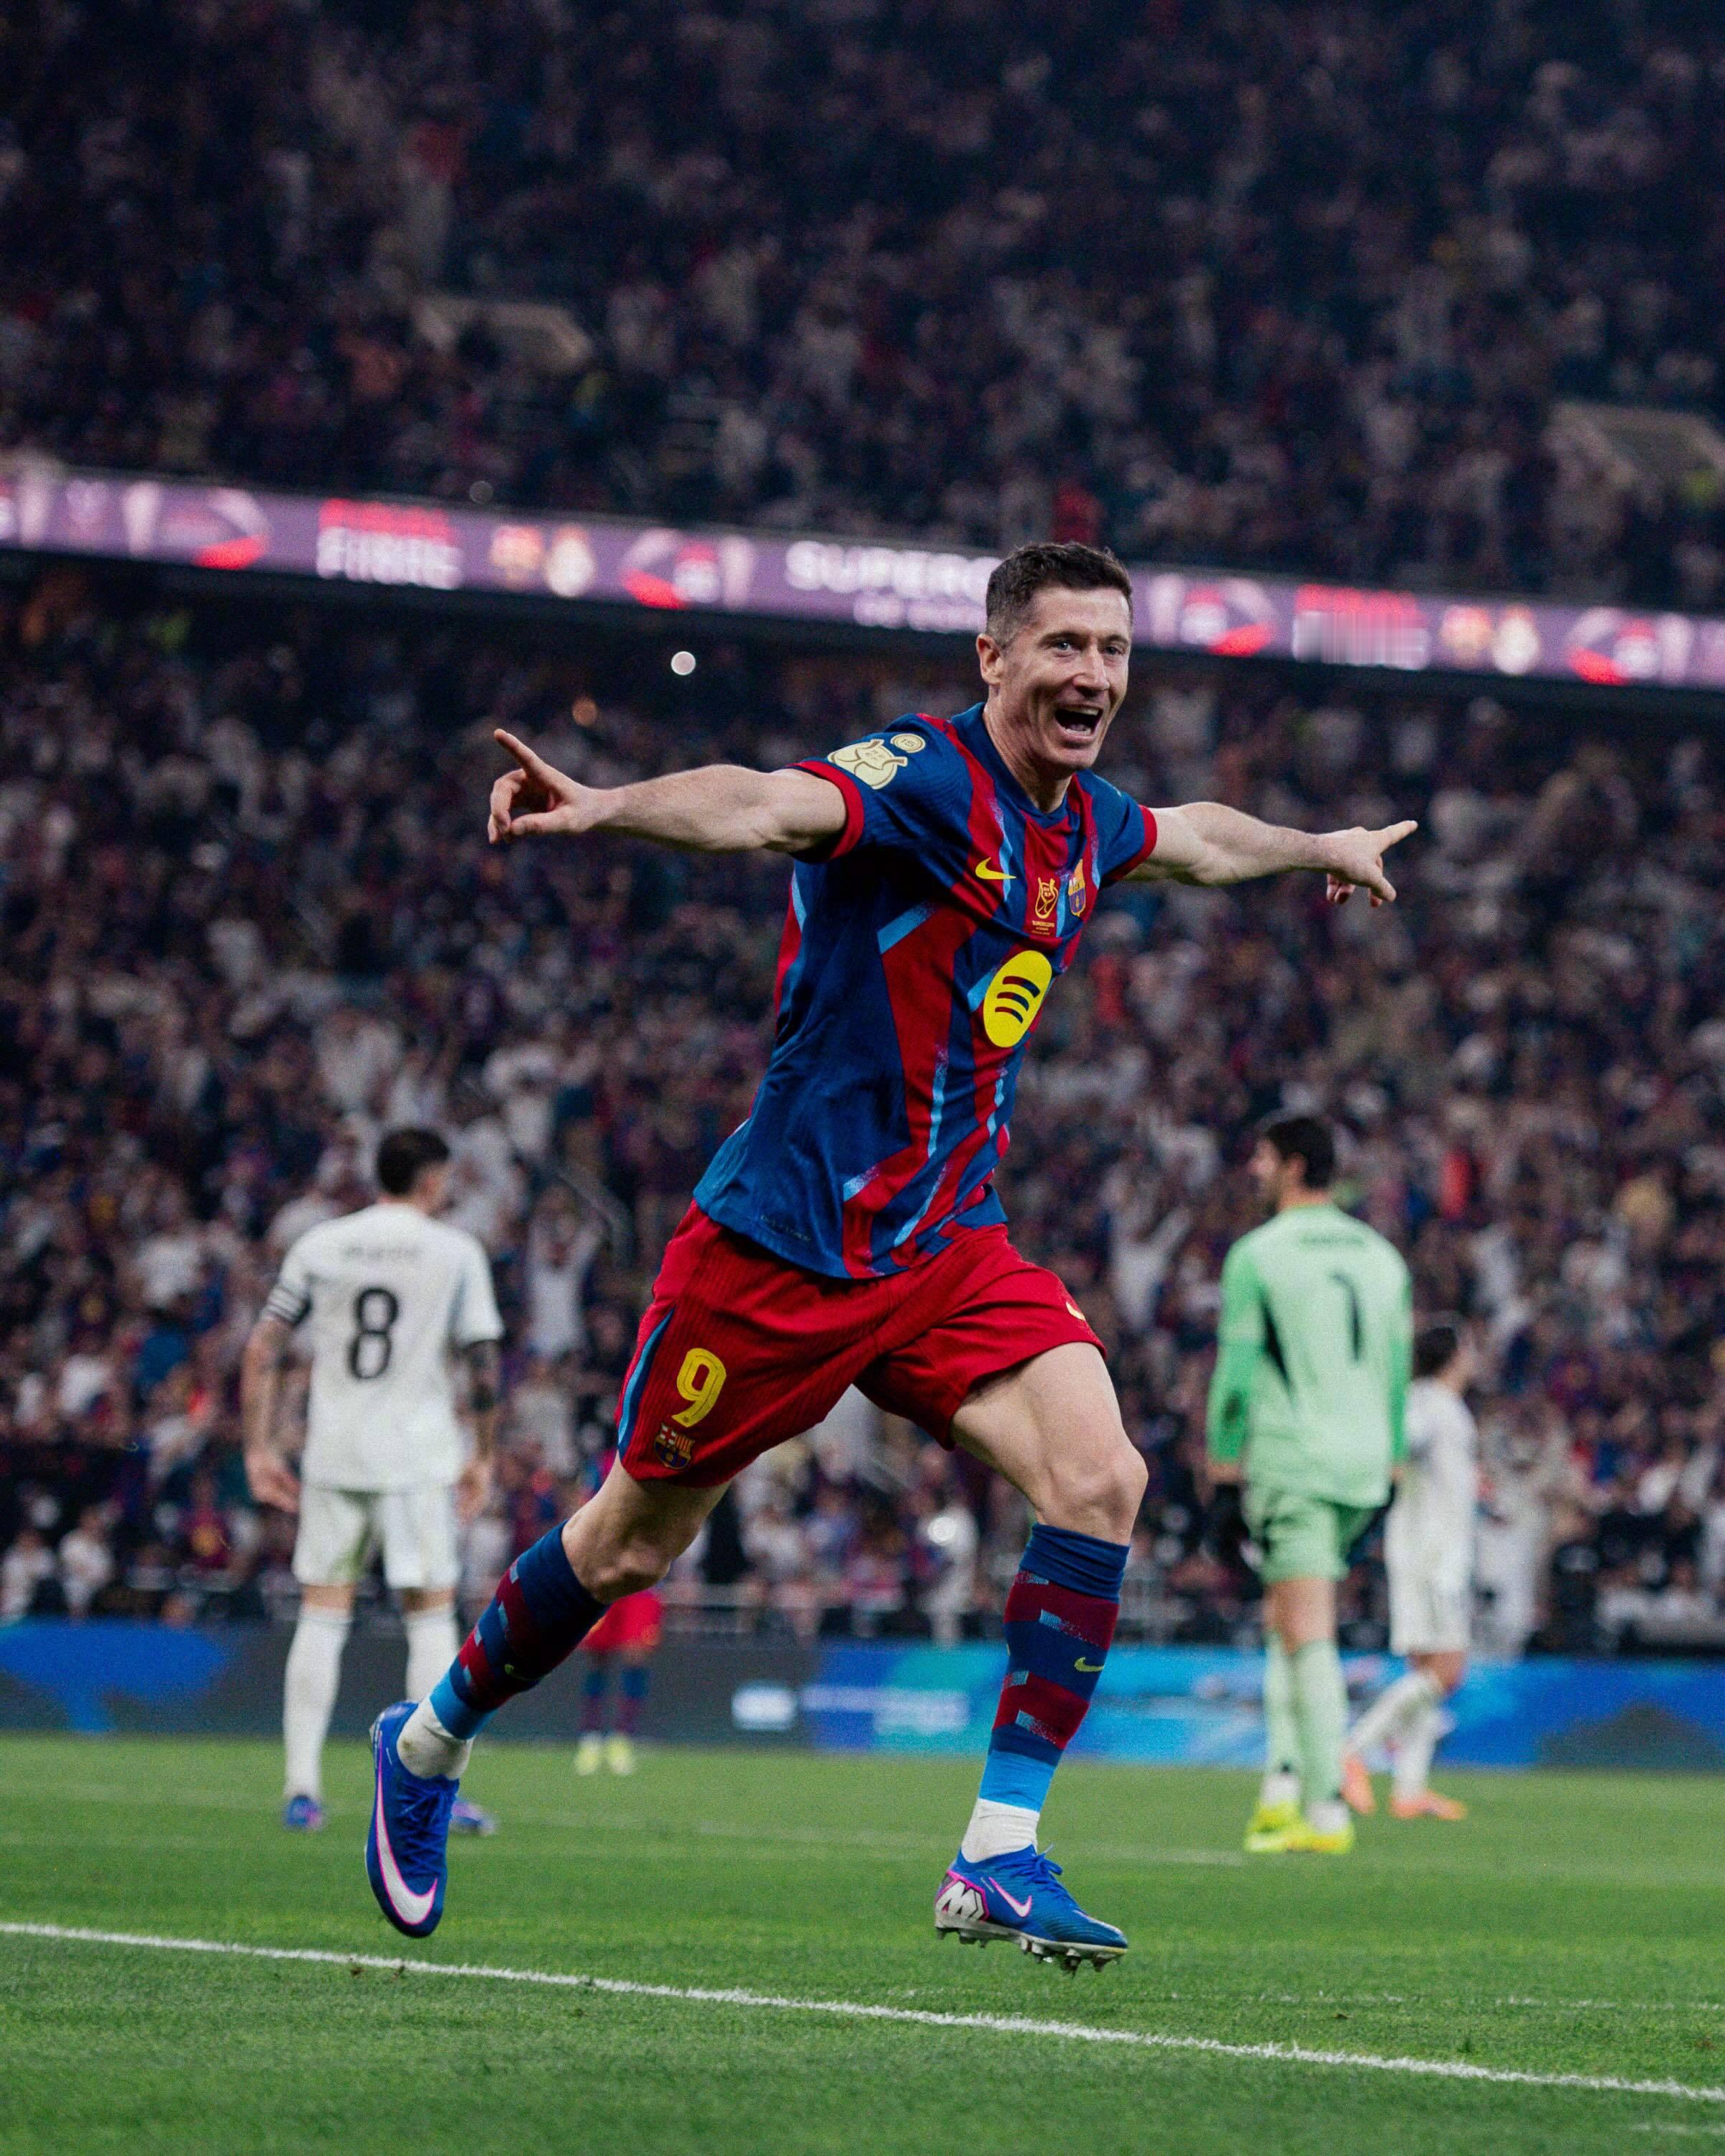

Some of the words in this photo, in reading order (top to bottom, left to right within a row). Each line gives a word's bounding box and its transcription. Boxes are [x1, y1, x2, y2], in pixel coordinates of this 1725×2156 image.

[349, 1286, 399, 1381] 8
[1331, 1271, 1363, 1364] 1
[671, 1348, 727, 1428] 9
